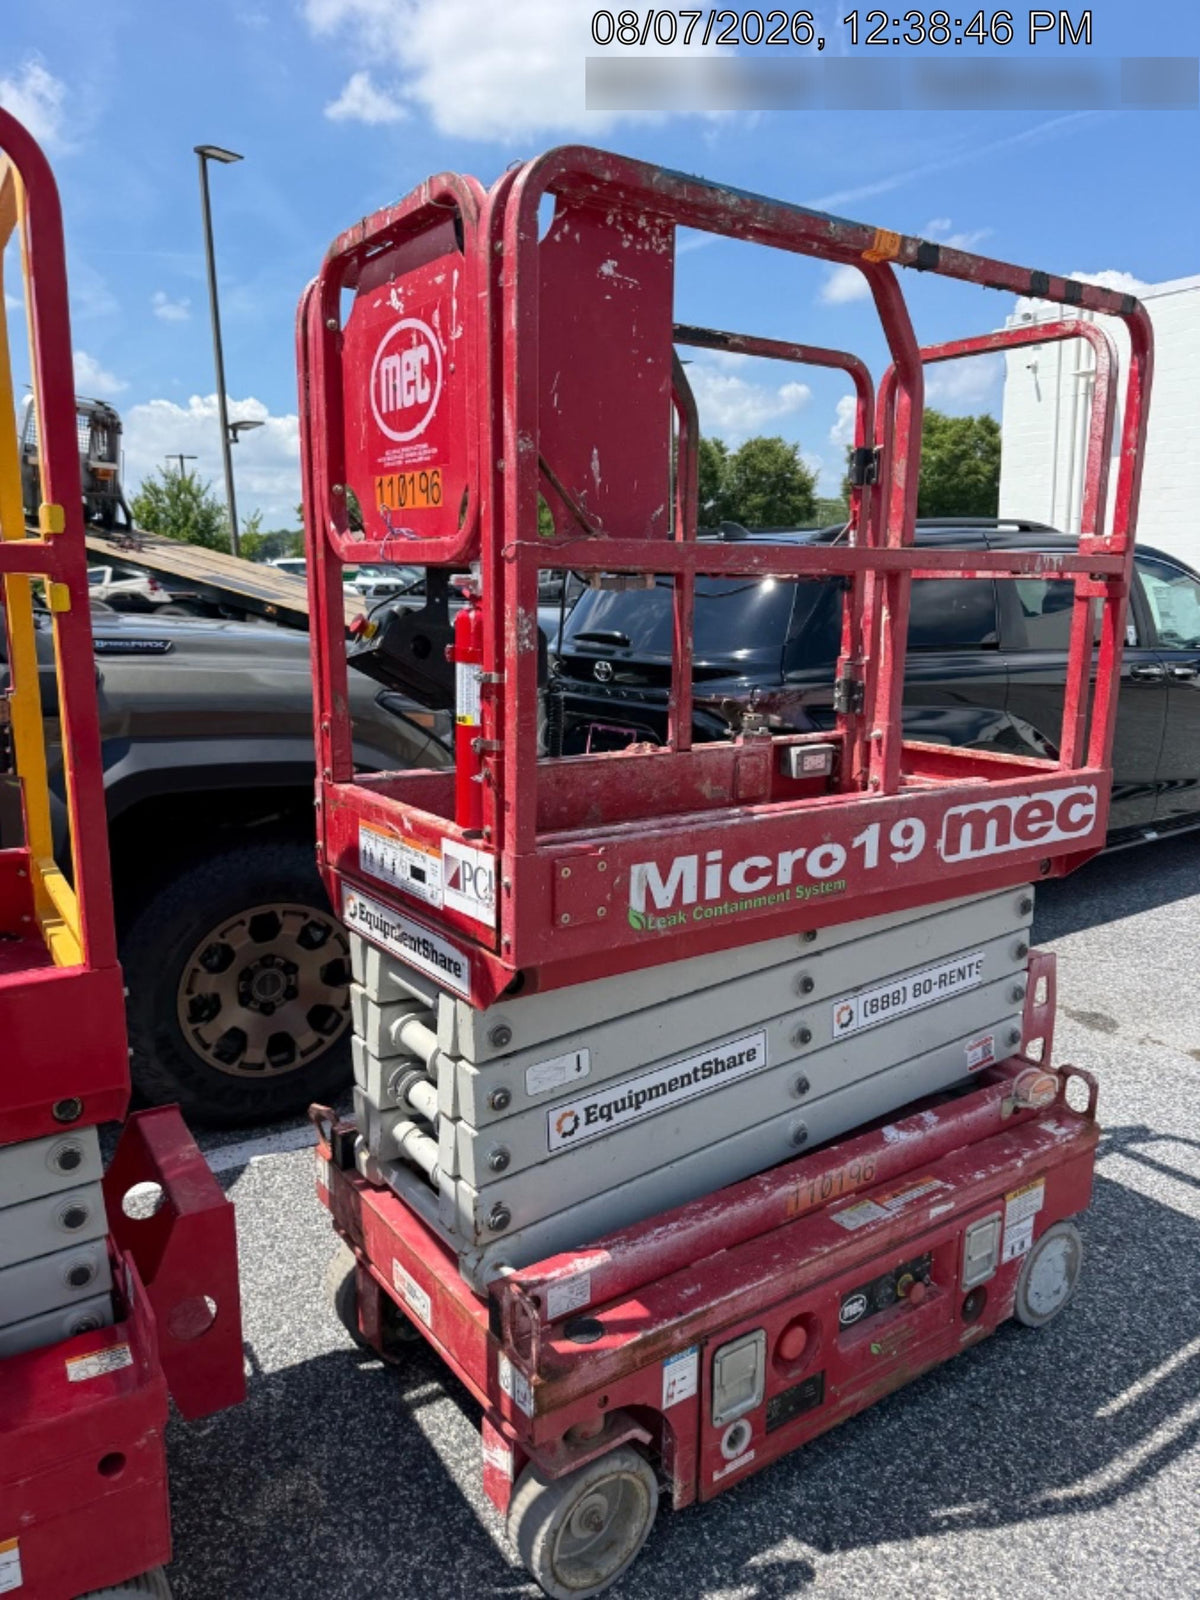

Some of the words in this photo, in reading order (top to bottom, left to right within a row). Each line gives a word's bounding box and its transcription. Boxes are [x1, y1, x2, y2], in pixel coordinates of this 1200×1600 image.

[377, 470, 441, 508] 110196
[944, 792, 1094, 856] mec
[647, 910, 687, 930] Leak
[692, 889, 791, 920] Containment
[795, 879, 846, 900] System
[358, 902, 463, 979] EquipmentShare
[863, 986, 907, 1018] (888)
[584, 1047, 757, 1126] EquipmentShare
